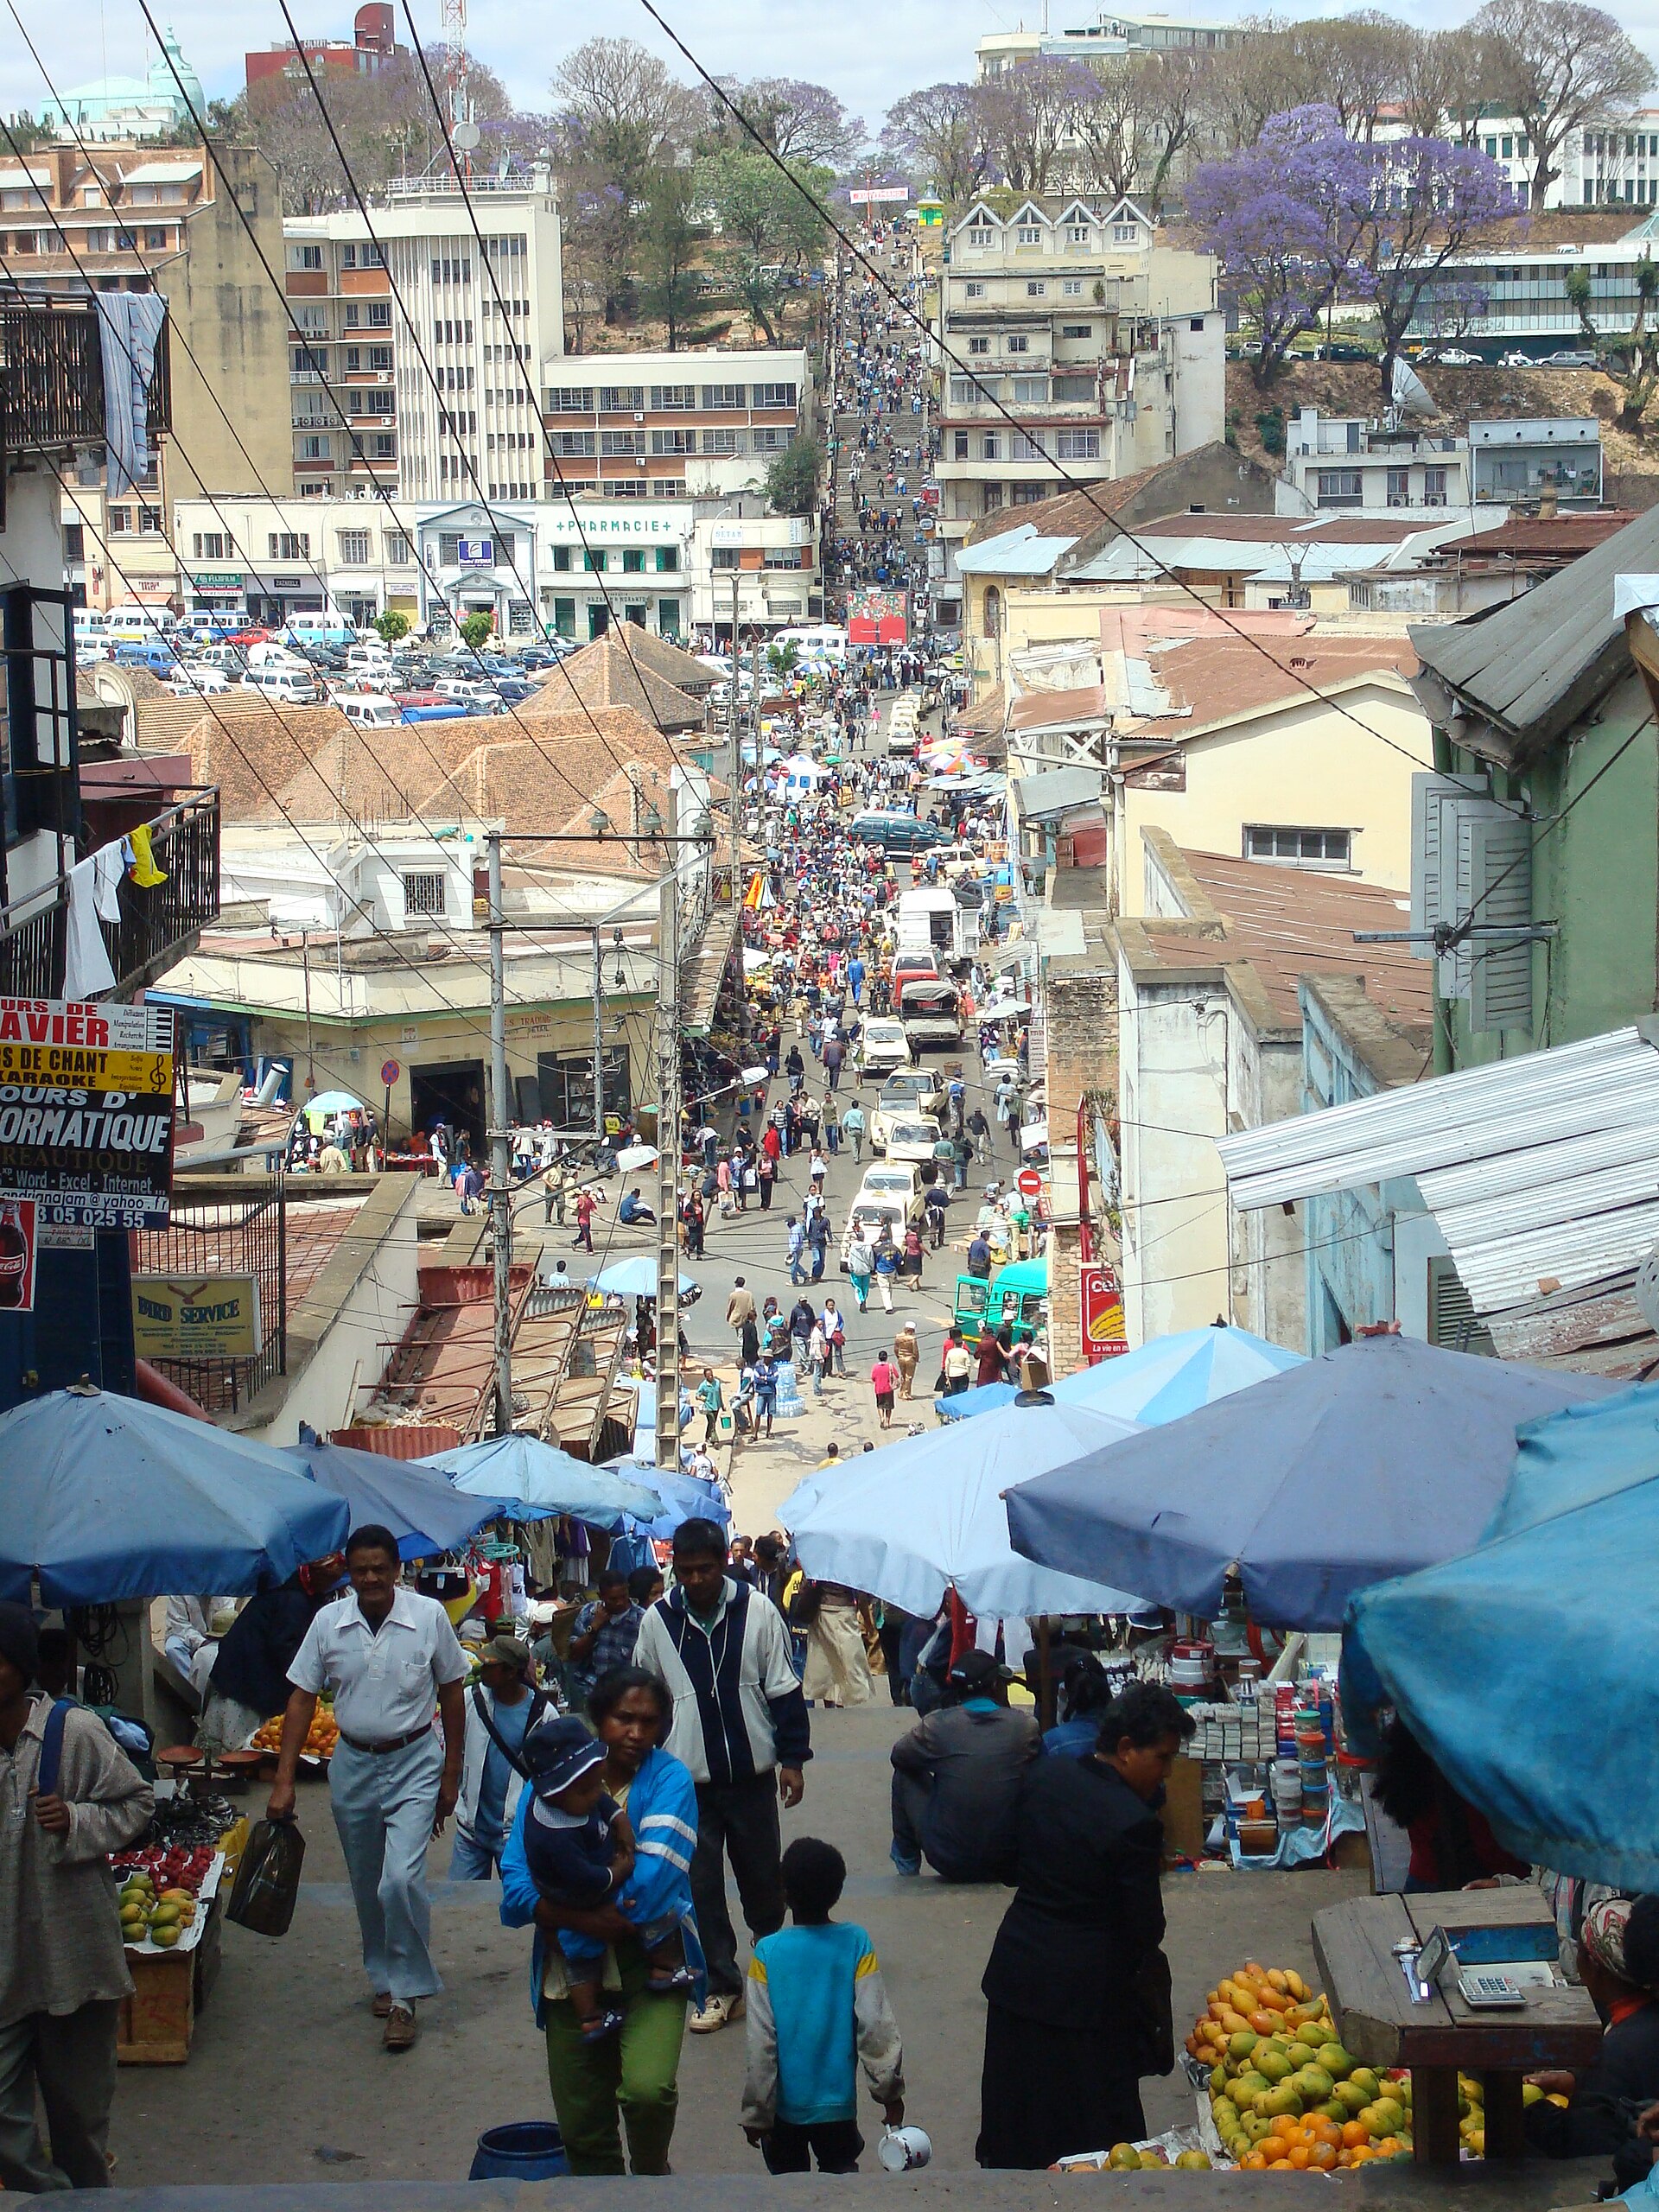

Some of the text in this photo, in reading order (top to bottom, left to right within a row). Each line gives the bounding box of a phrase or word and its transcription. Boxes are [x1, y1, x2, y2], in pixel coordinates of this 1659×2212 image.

[569, 520, 659, 532] PHARMACIE
[1, 999, 98, 1017] URS DE
[0, 1012, 110, 1047] AVIER
[0, 1046, 109, 1074] S DE CHANT
[0, 1085, 89, 1106] OURS
[0, 1106, 171, 1154] ORMATIQUE
[16, 1170, 48, 1189] Word
[59, 1172, 91, 1192] Excel
[104, 1196, 144, 1211] yahoo
[54, 1206, 76, 1224] 05
[83, 1208, 118, 1227] 025
[123, 1211, 146, 1230] 55
[137, 1295, 240, 1324] BIRD SERVICE
[1092, 1344, 1101, 1352] La
[1103, 1344, 1113, 1352] vie
